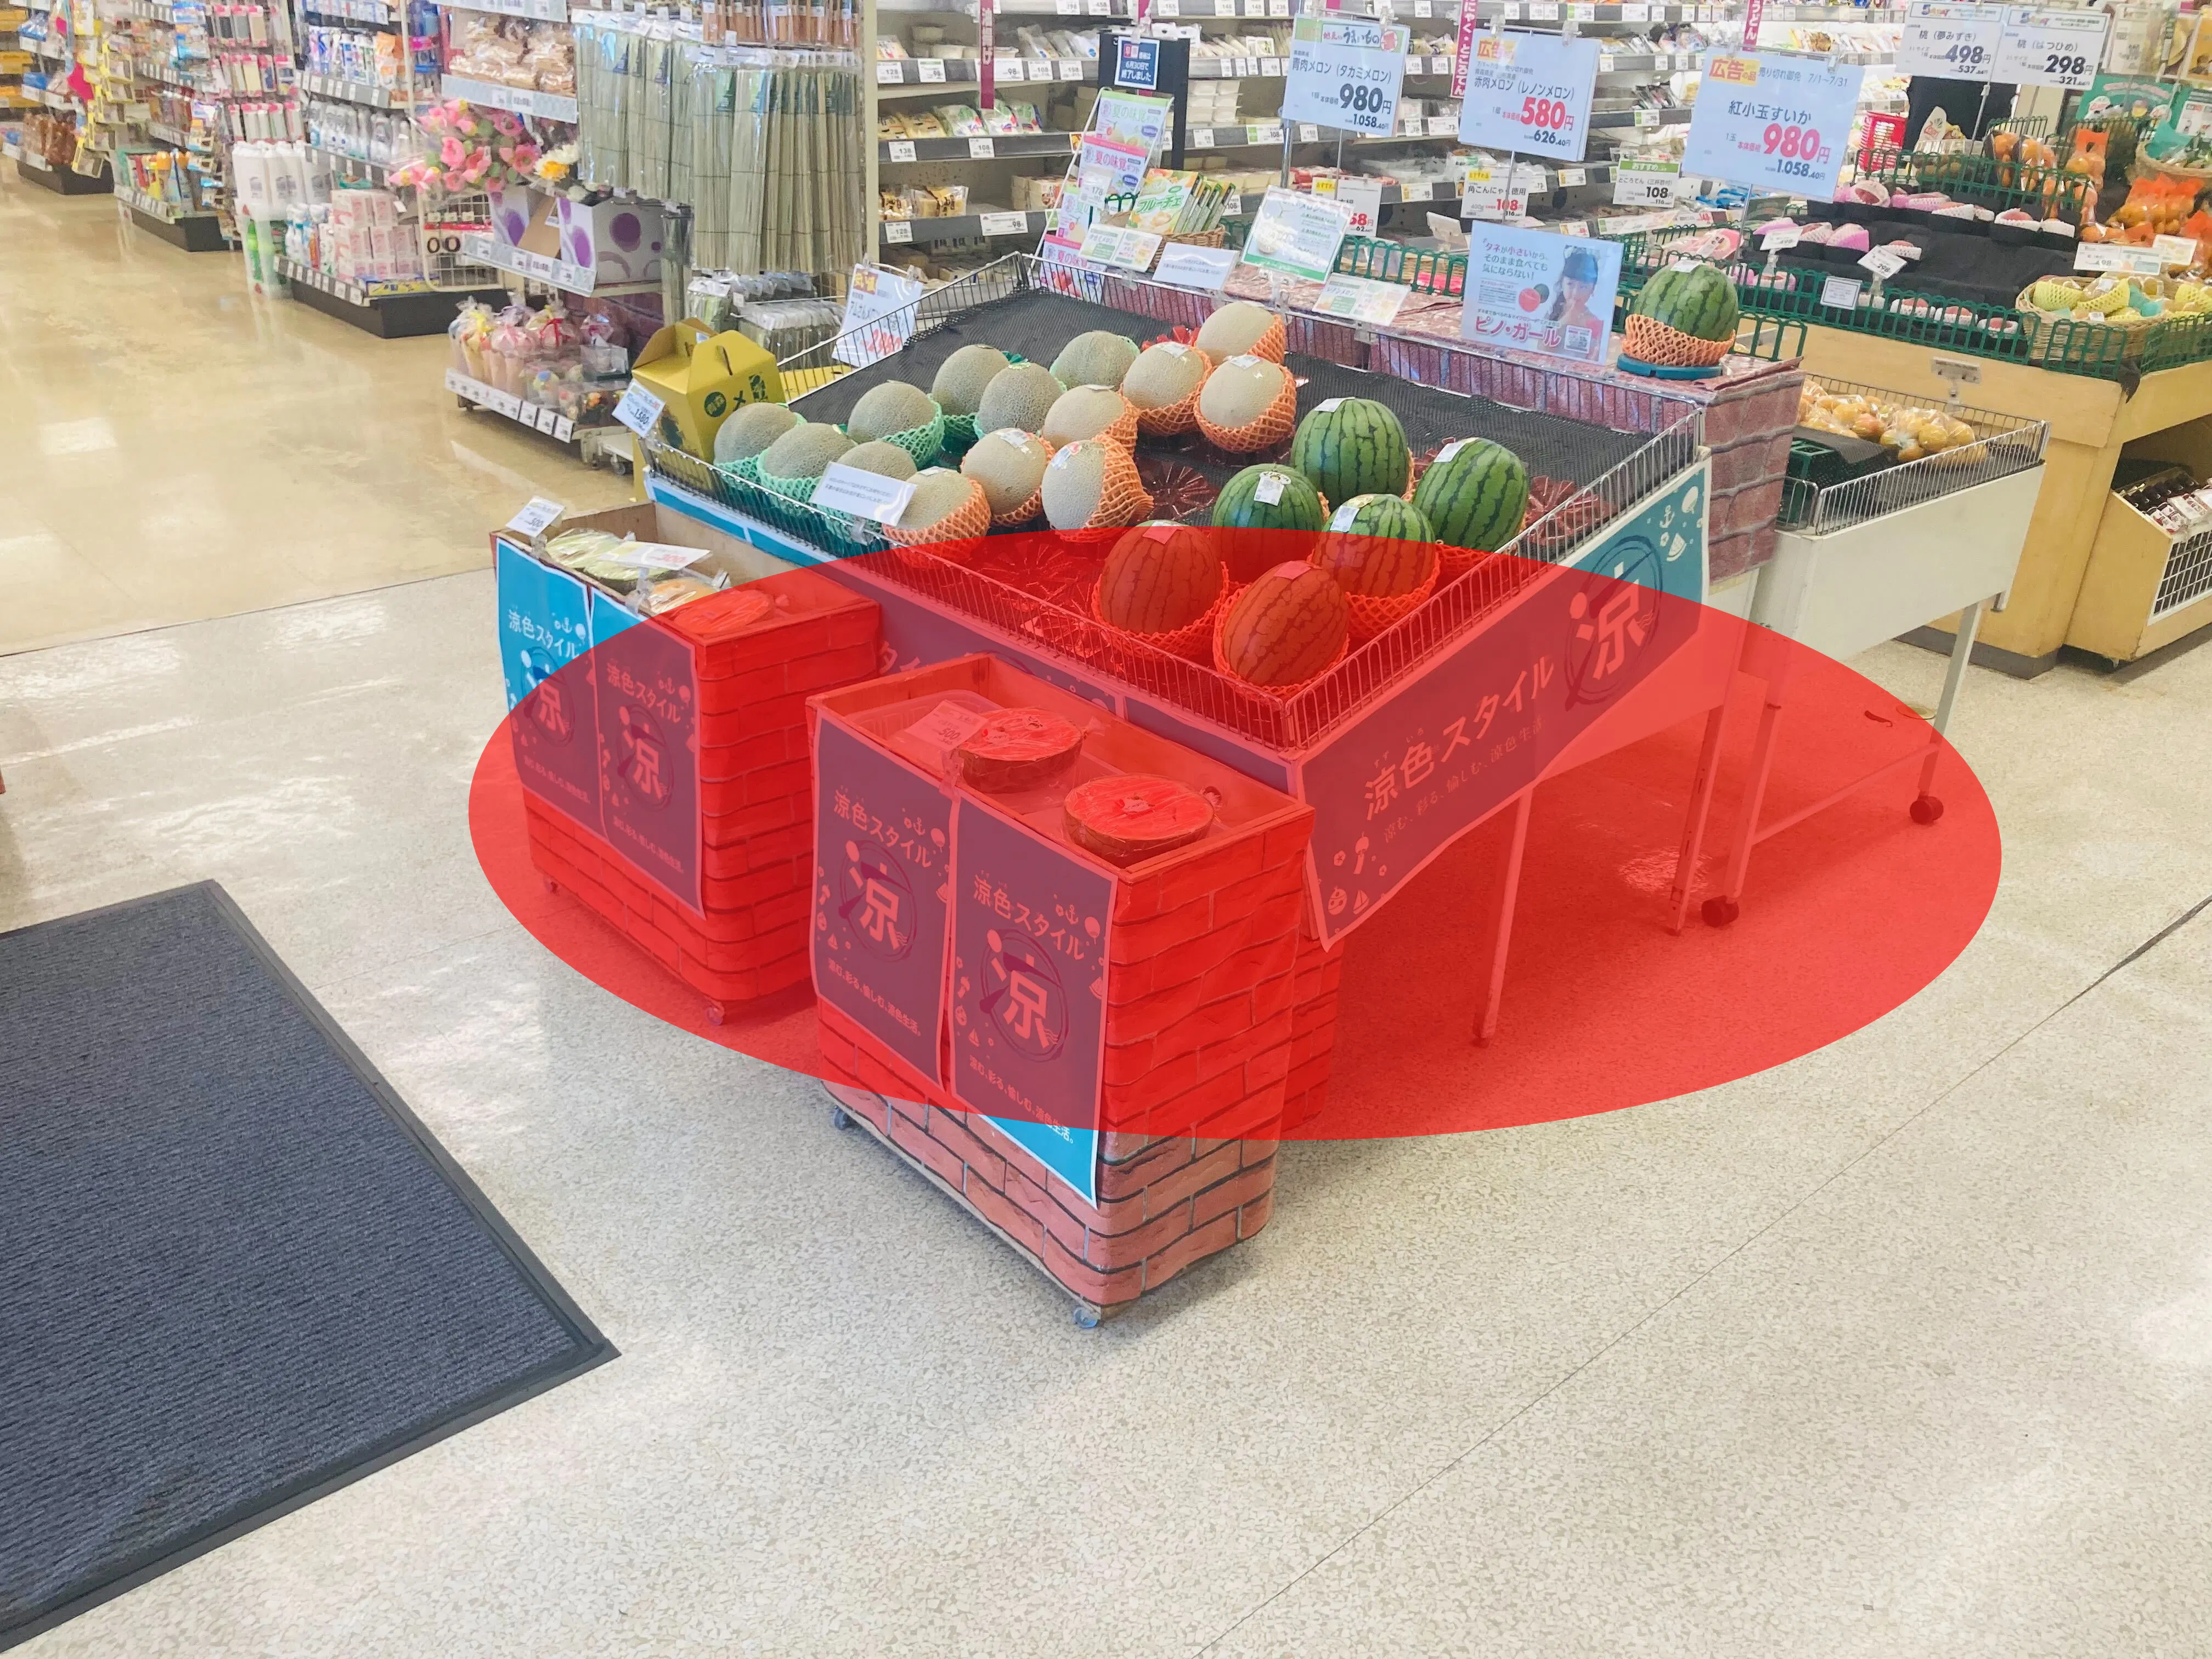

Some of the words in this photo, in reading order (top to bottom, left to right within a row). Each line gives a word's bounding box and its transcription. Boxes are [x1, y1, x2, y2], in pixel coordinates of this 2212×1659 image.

[1008, 67, 1018, 76] 98
[1340, 83, 1392, 115] 980円
[1520, 96, 1575, 131] 580円
[1728, 100, 1812, 125] 紅小玉すいか
[1763, 123, 1831, 165] 980円
[1137, 194, 1184, 213] フルーチェ
[1484, 253, 1548, 272] そのまま食べても
[1475, 315, 1562, 347] ピノ・ガール
[507, 608, 582, 659] 涼色スタイル
[1570, 560, 1645, 680] 涼
[606, 661, 681, 724] 涼色スタイル
[938, 727, 961, 740] 500
[1364, 653, 1556, 822] 涼色スタイル
[833, 789, 932, 868] 涼色スタイル
[974, 874, 1085, 961] 涼色スタイル
